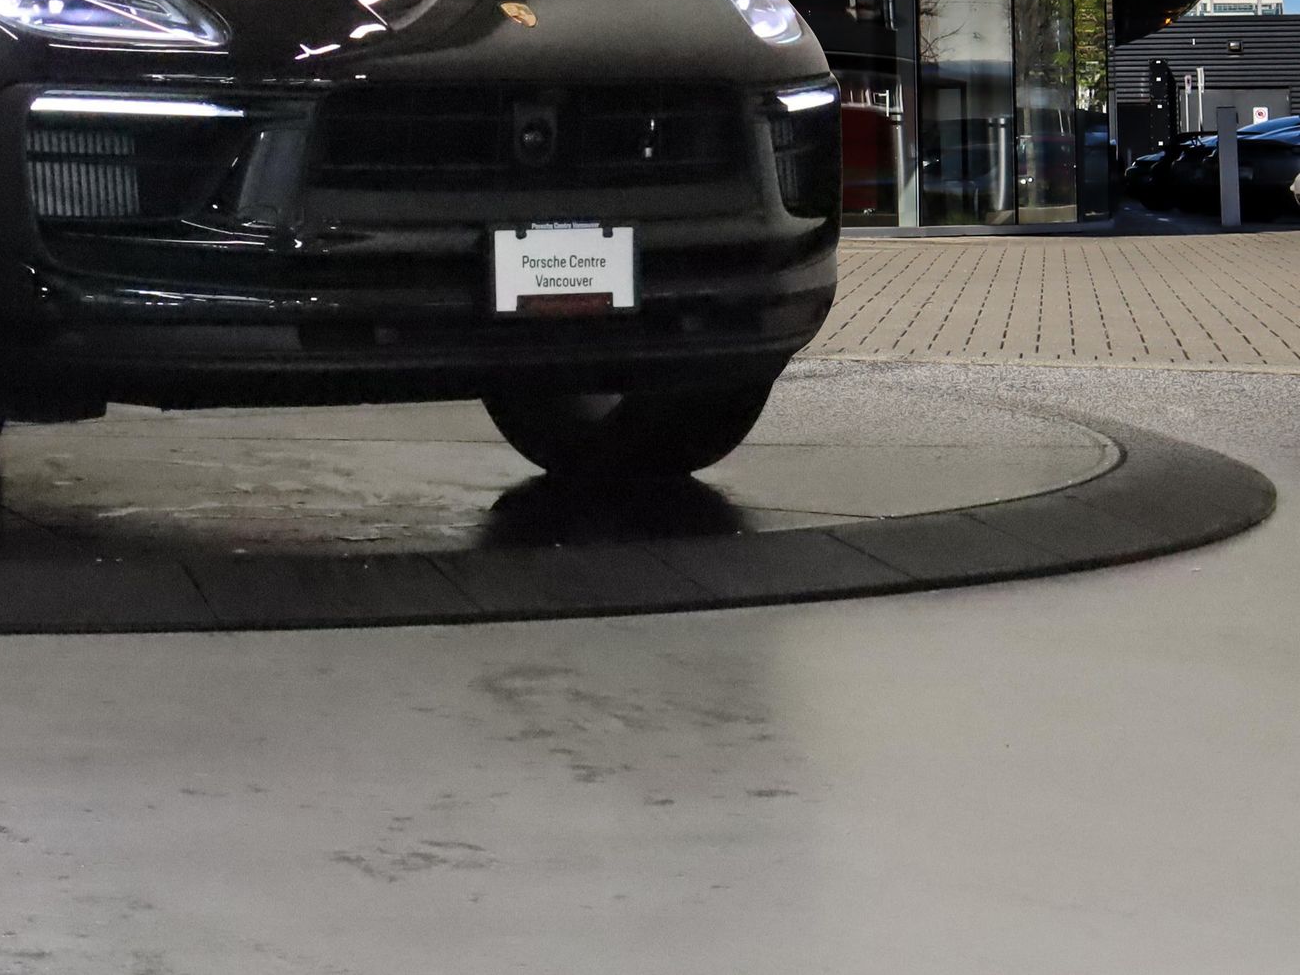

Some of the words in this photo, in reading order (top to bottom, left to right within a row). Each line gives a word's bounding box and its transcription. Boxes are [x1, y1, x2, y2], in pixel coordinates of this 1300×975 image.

[522, 255, 566, 268] Porsche
[569, 254, 606, 268] Centre
[535, 274, 593, 287] Vancouver
